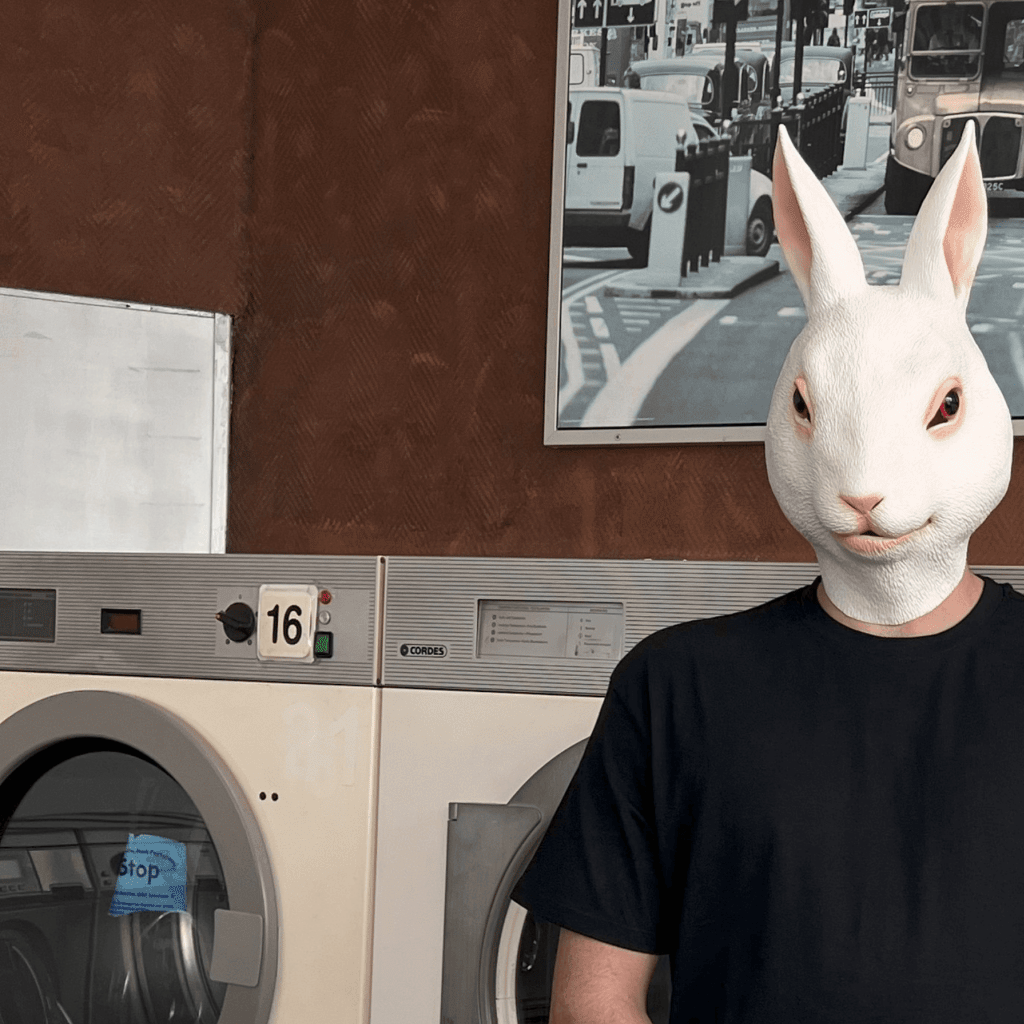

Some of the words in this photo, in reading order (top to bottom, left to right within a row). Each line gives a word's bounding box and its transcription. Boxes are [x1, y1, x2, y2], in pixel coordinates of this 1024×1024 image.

[267, 604, 302, 645] 16
[410, 646, 444, 656] CORDES
[119, 857, 160, 885] Stop
